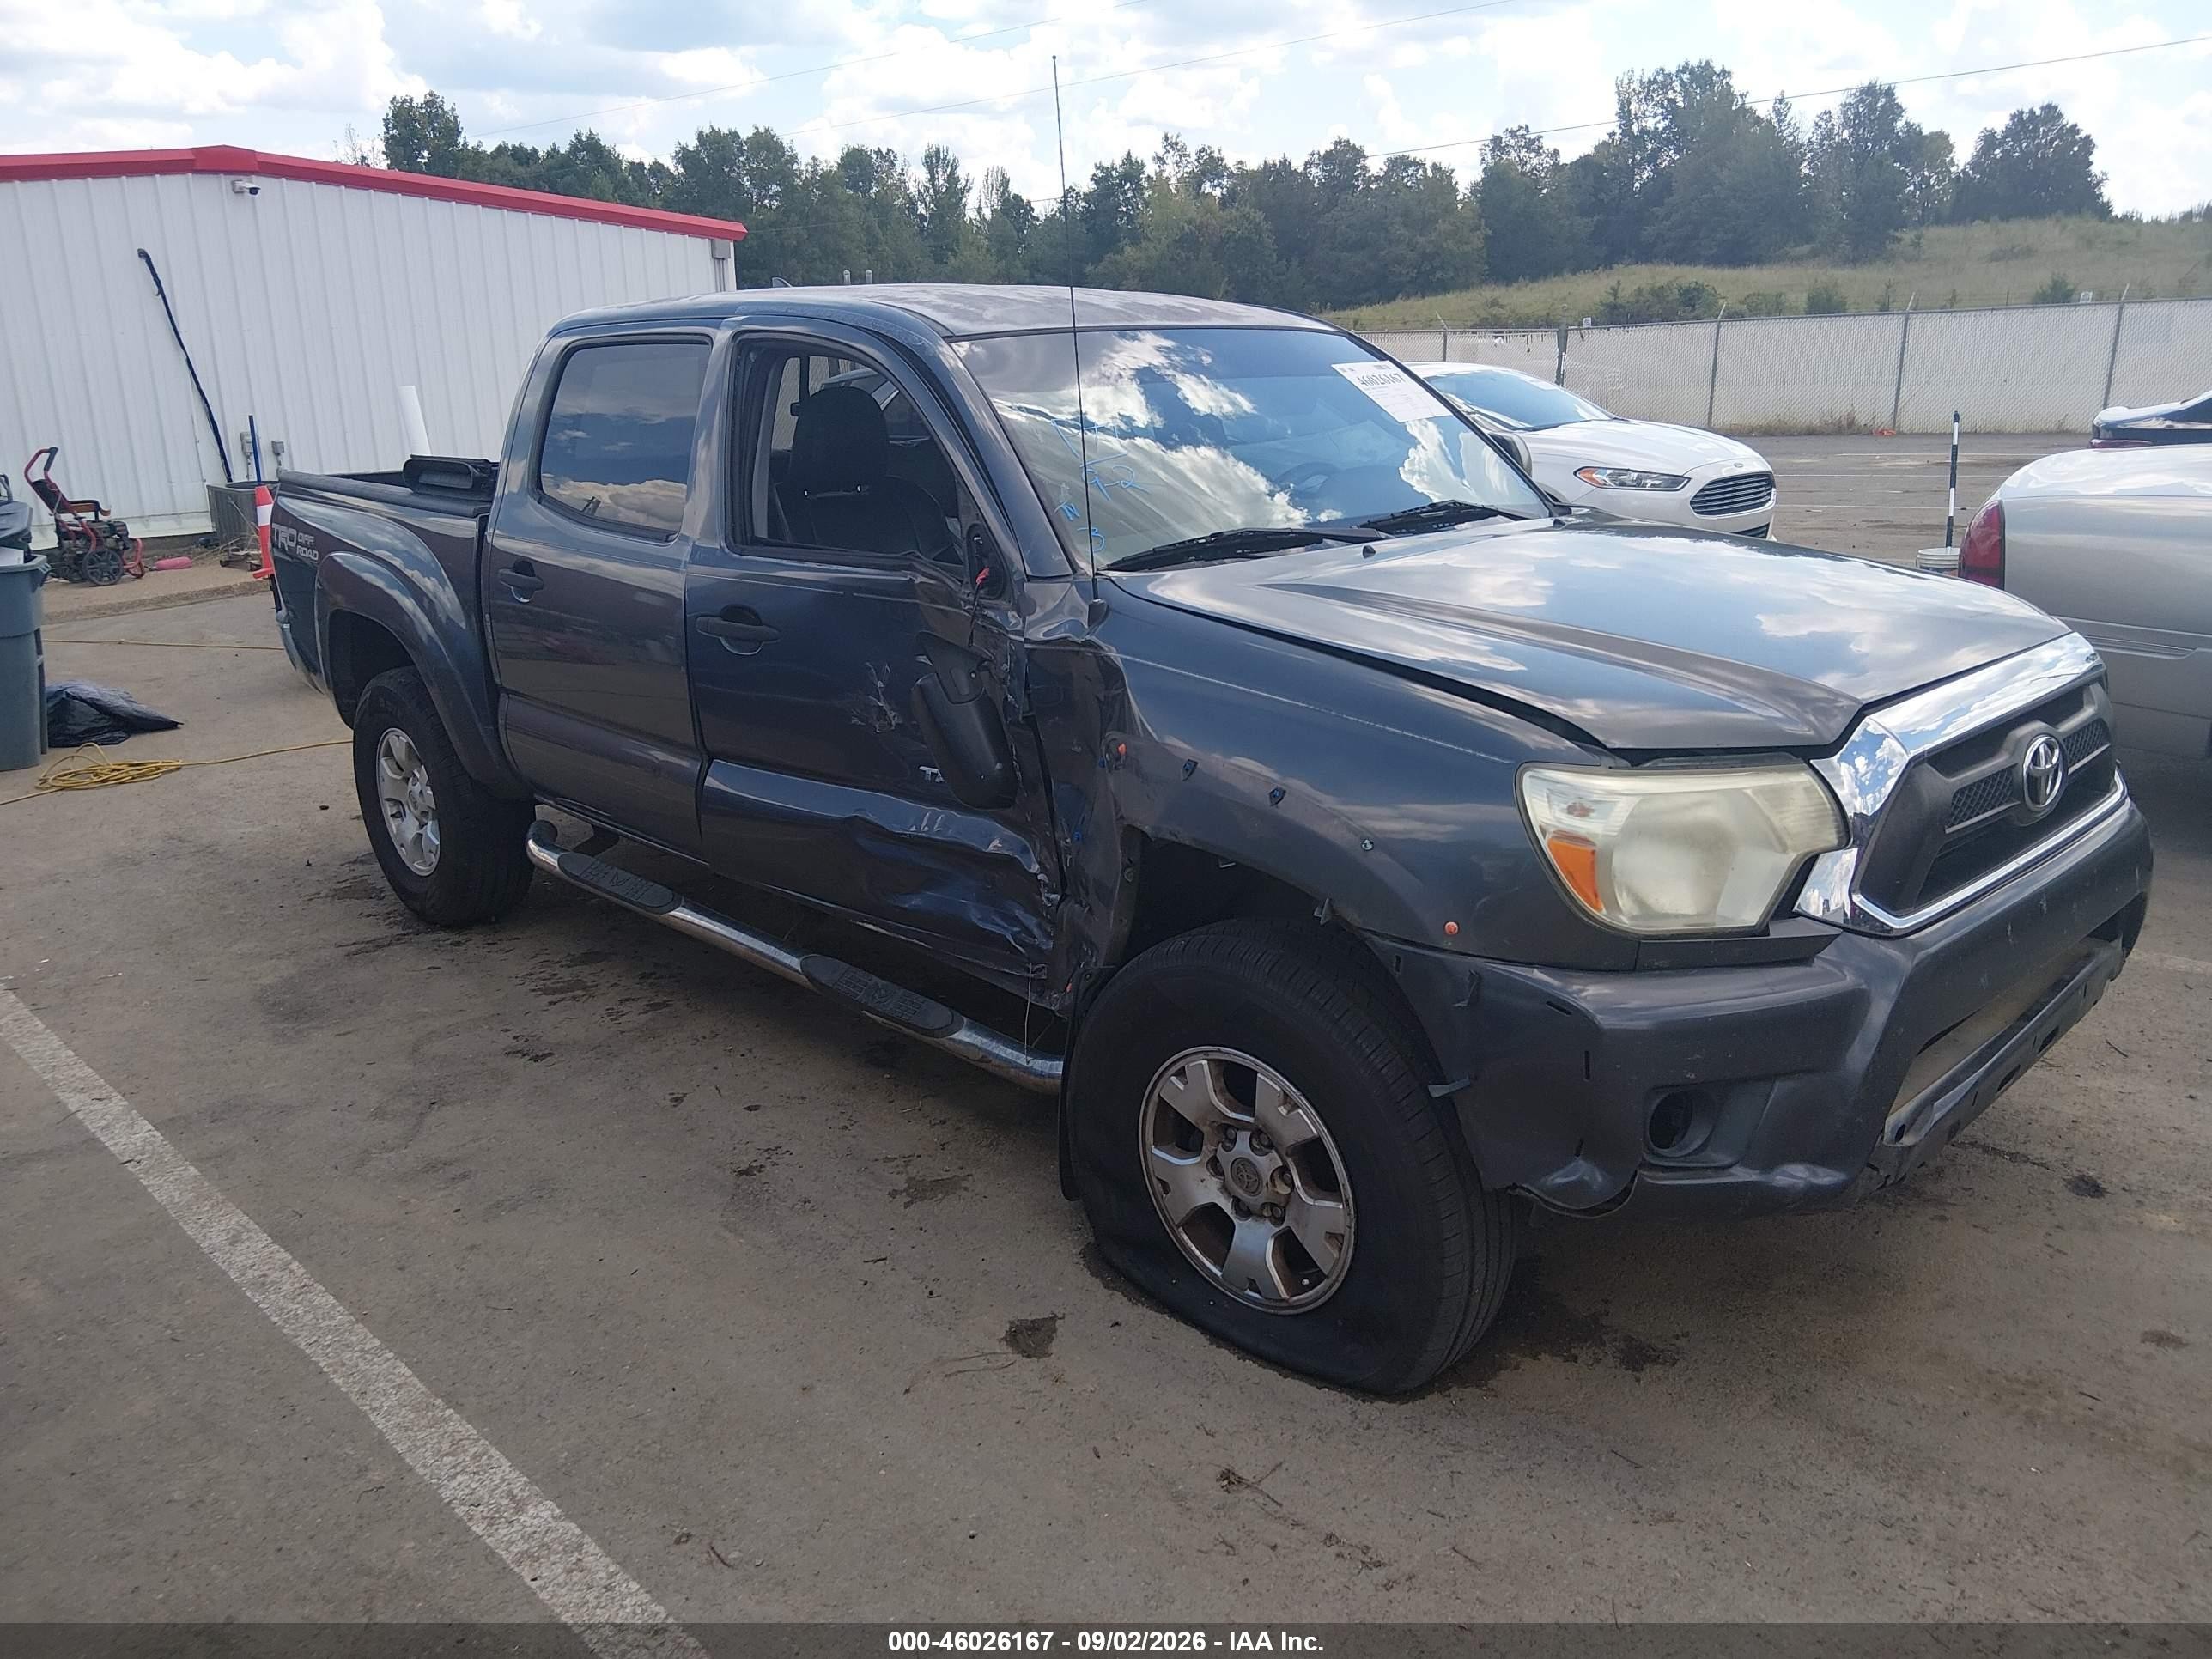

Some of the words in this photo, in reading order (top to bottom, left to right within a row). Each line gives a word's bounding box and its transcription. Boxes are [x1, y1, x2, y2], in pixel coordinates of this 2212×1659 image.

[271, 523, 297, 551] TRD
[297, 532, 315, 545] OFF
[296, 545, 319, 561] ROAD
